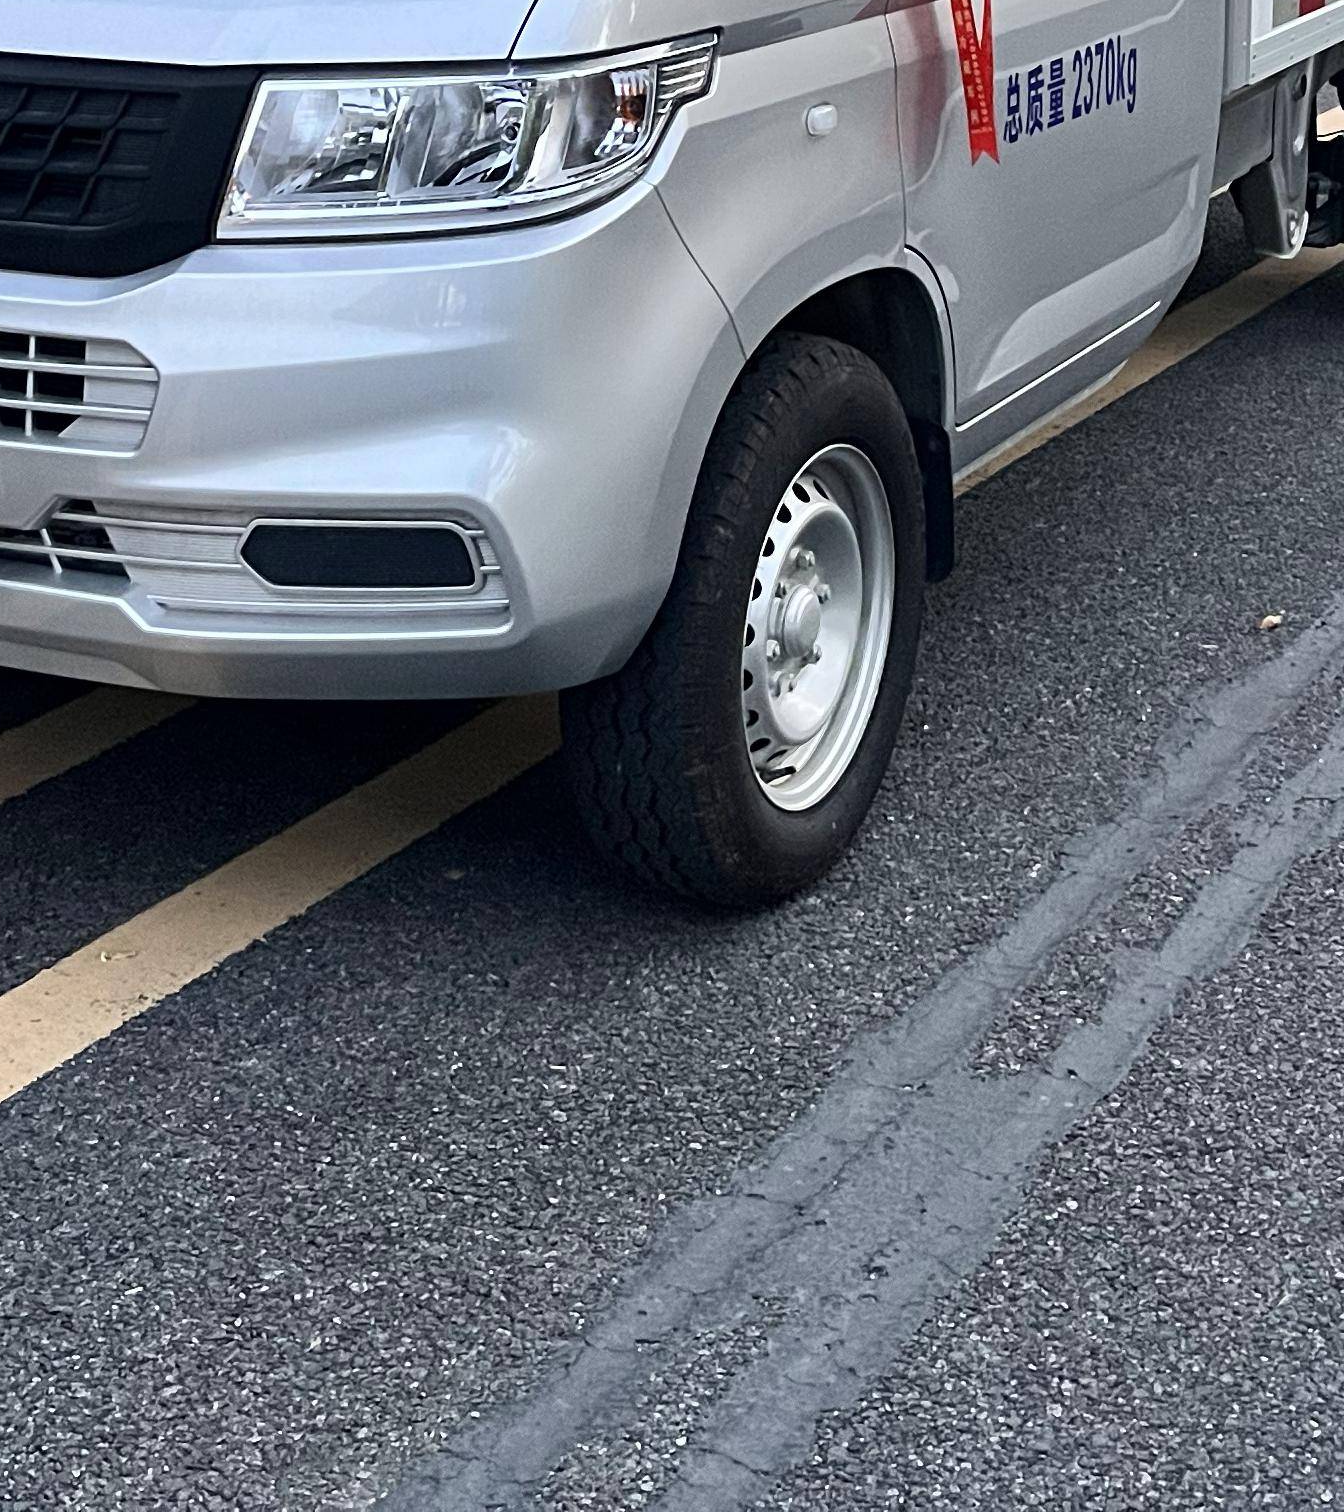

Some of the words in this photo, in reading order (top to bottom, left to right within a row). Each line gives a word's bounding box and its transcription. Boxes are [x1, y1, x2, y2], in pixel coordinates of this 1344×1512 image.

[1002, 56, 1065, 144] 总质量
[1071, 34, 1138, 120] 2370kg
